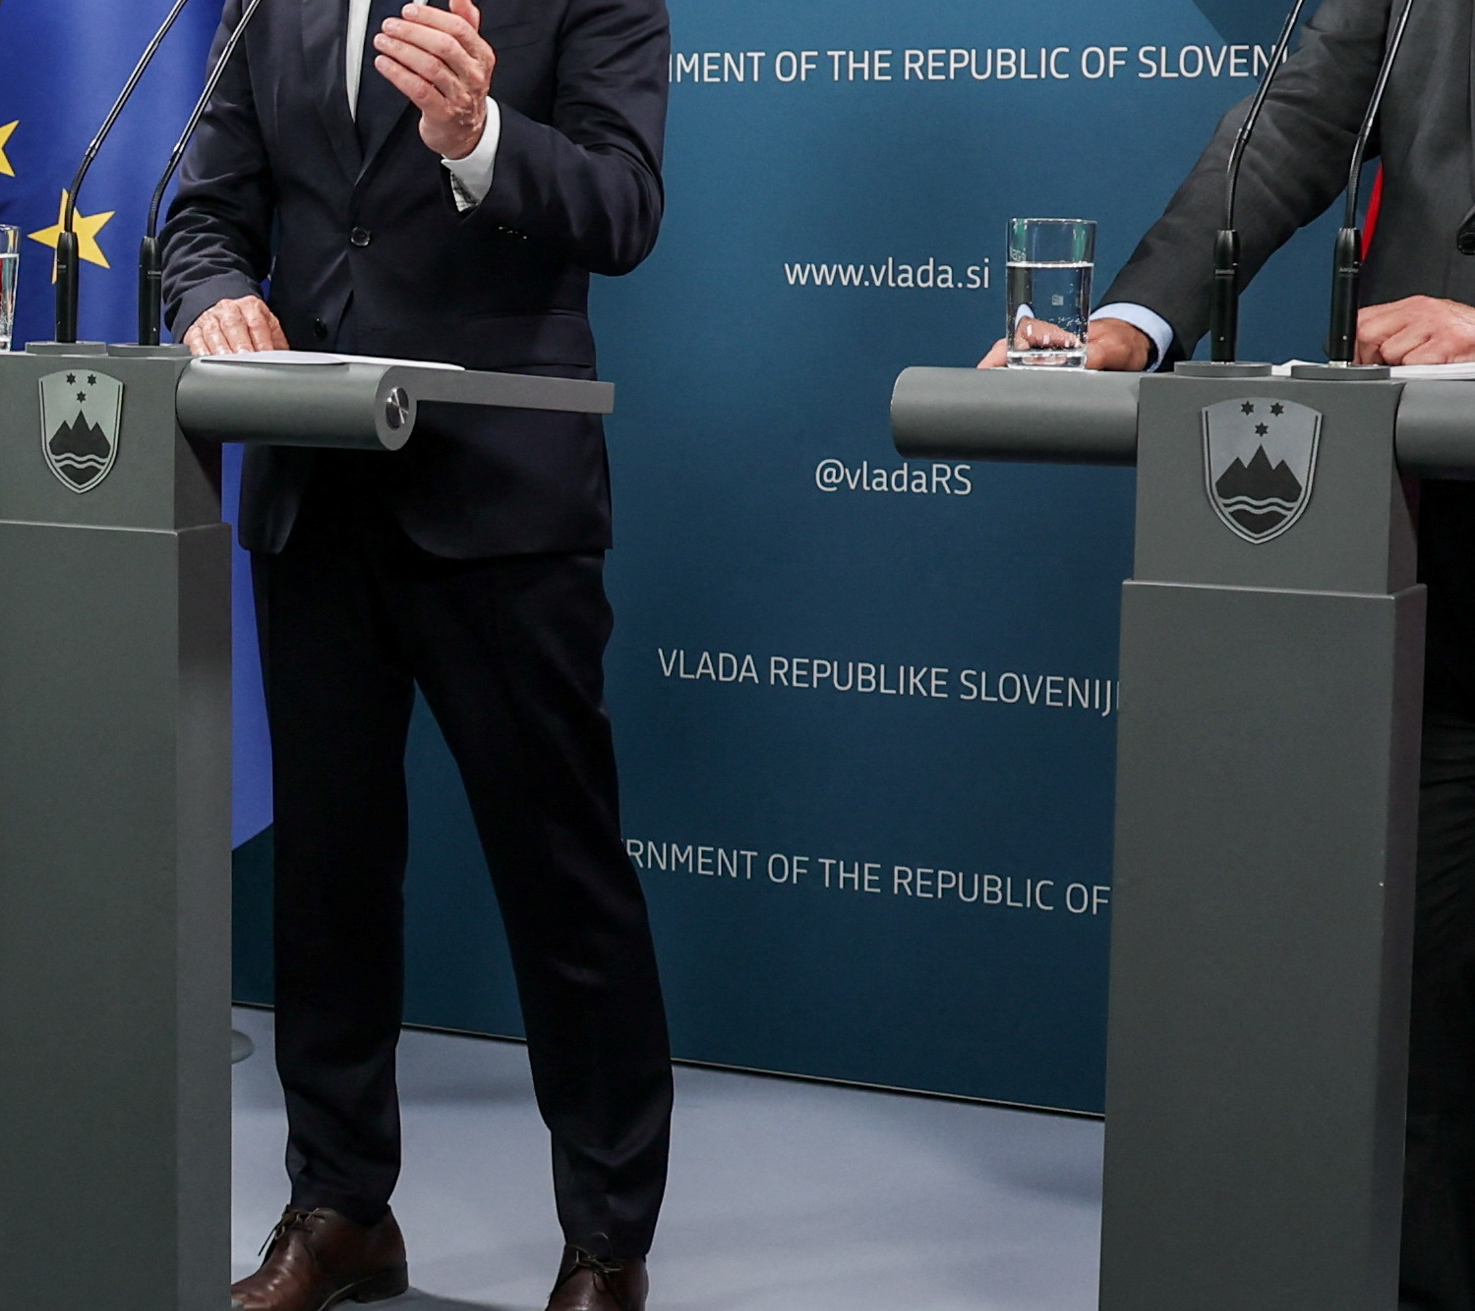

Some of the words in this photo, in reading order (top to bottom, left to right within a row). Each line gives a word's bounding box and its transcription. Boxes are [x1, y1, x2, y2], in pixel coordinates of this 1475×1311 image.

[775, 50, 819, 82] OF
[826, 49, 893, 81] THE
[900, 46, 1070, 80] REPUBLIC
[1081, 46, 1128, 79] OF
[784, 256, 990, 289] www.vlada.si
[815, 458, 972, 495] @vladaRS
[658, 647, 760, 684] VLADA
[770, 656, 949, 698] REPUBLIKE
[960, 669, 1119, 717] SLOVENIJ
[626, 839, 758, 880] RNMENT
[767, 853, 810, 885] OF
[817, 858, 882, 893] THE
[893, 865, 1054, 911] REPUBLIC
[1066, 882, 1111, 915] OF
